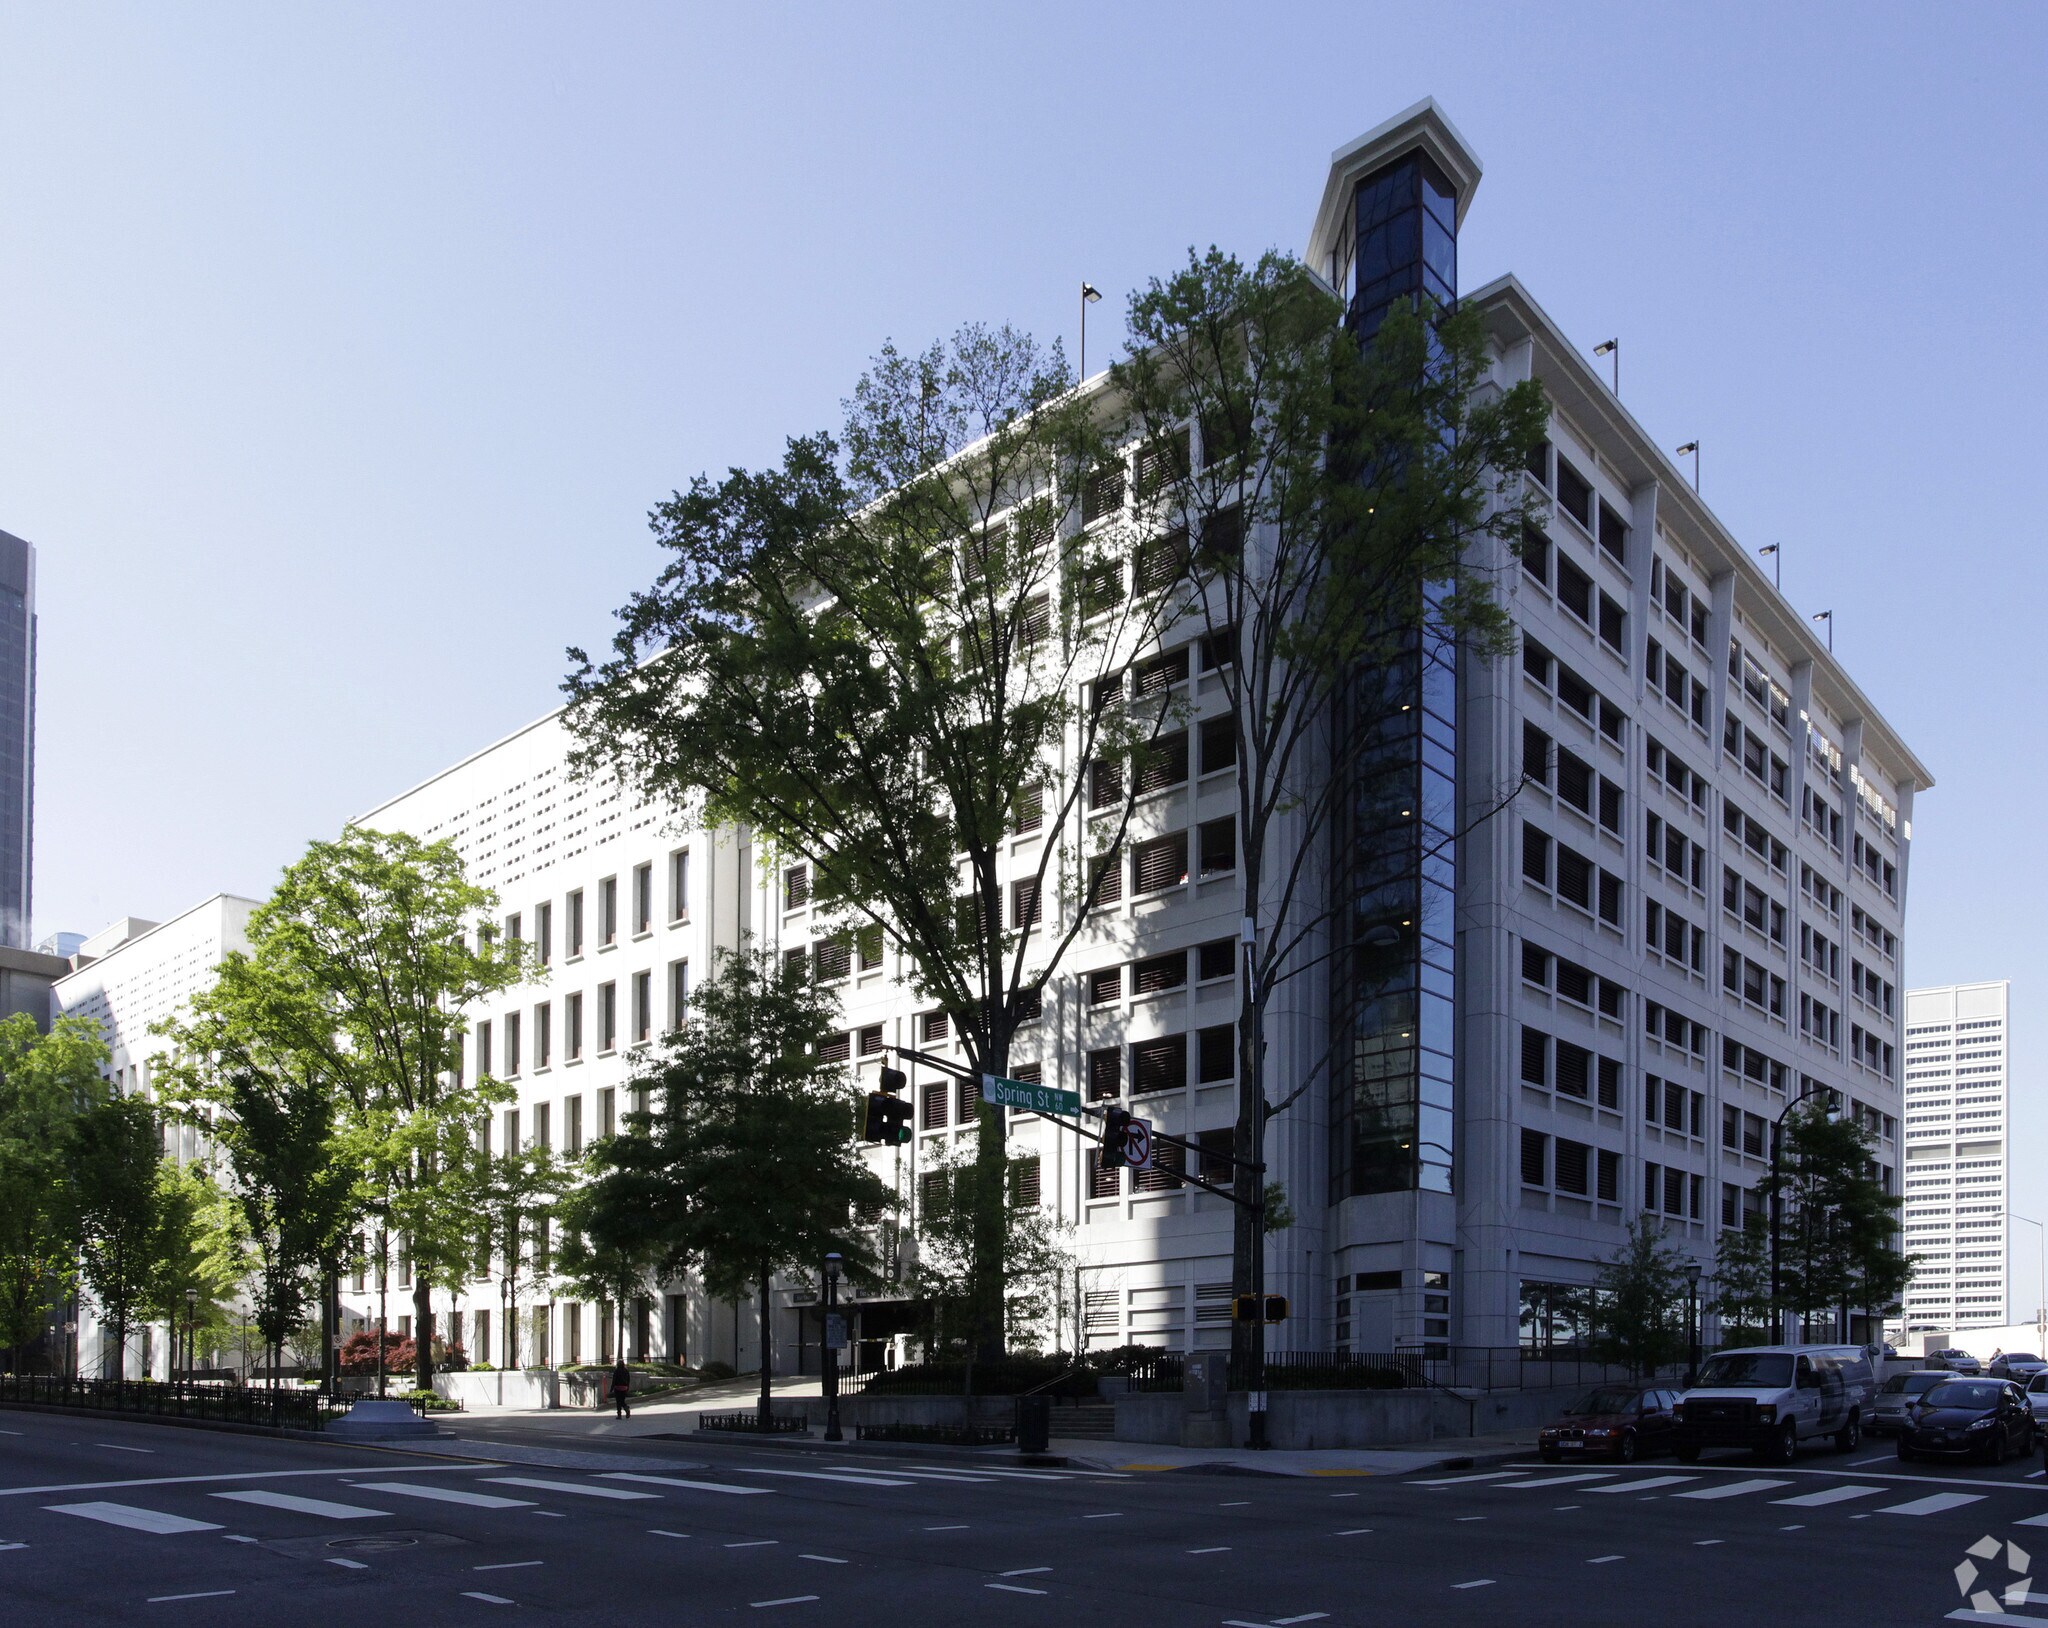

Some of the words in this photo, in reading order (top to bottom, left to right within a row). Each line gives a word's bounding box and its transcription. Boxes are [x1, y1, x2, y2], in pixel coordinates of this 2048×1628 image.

[997, 1083, 1032, 1109] Spring
[1037, 1090, 1050, 1108] St
[1054, 1093, 1063, 1102] NW
